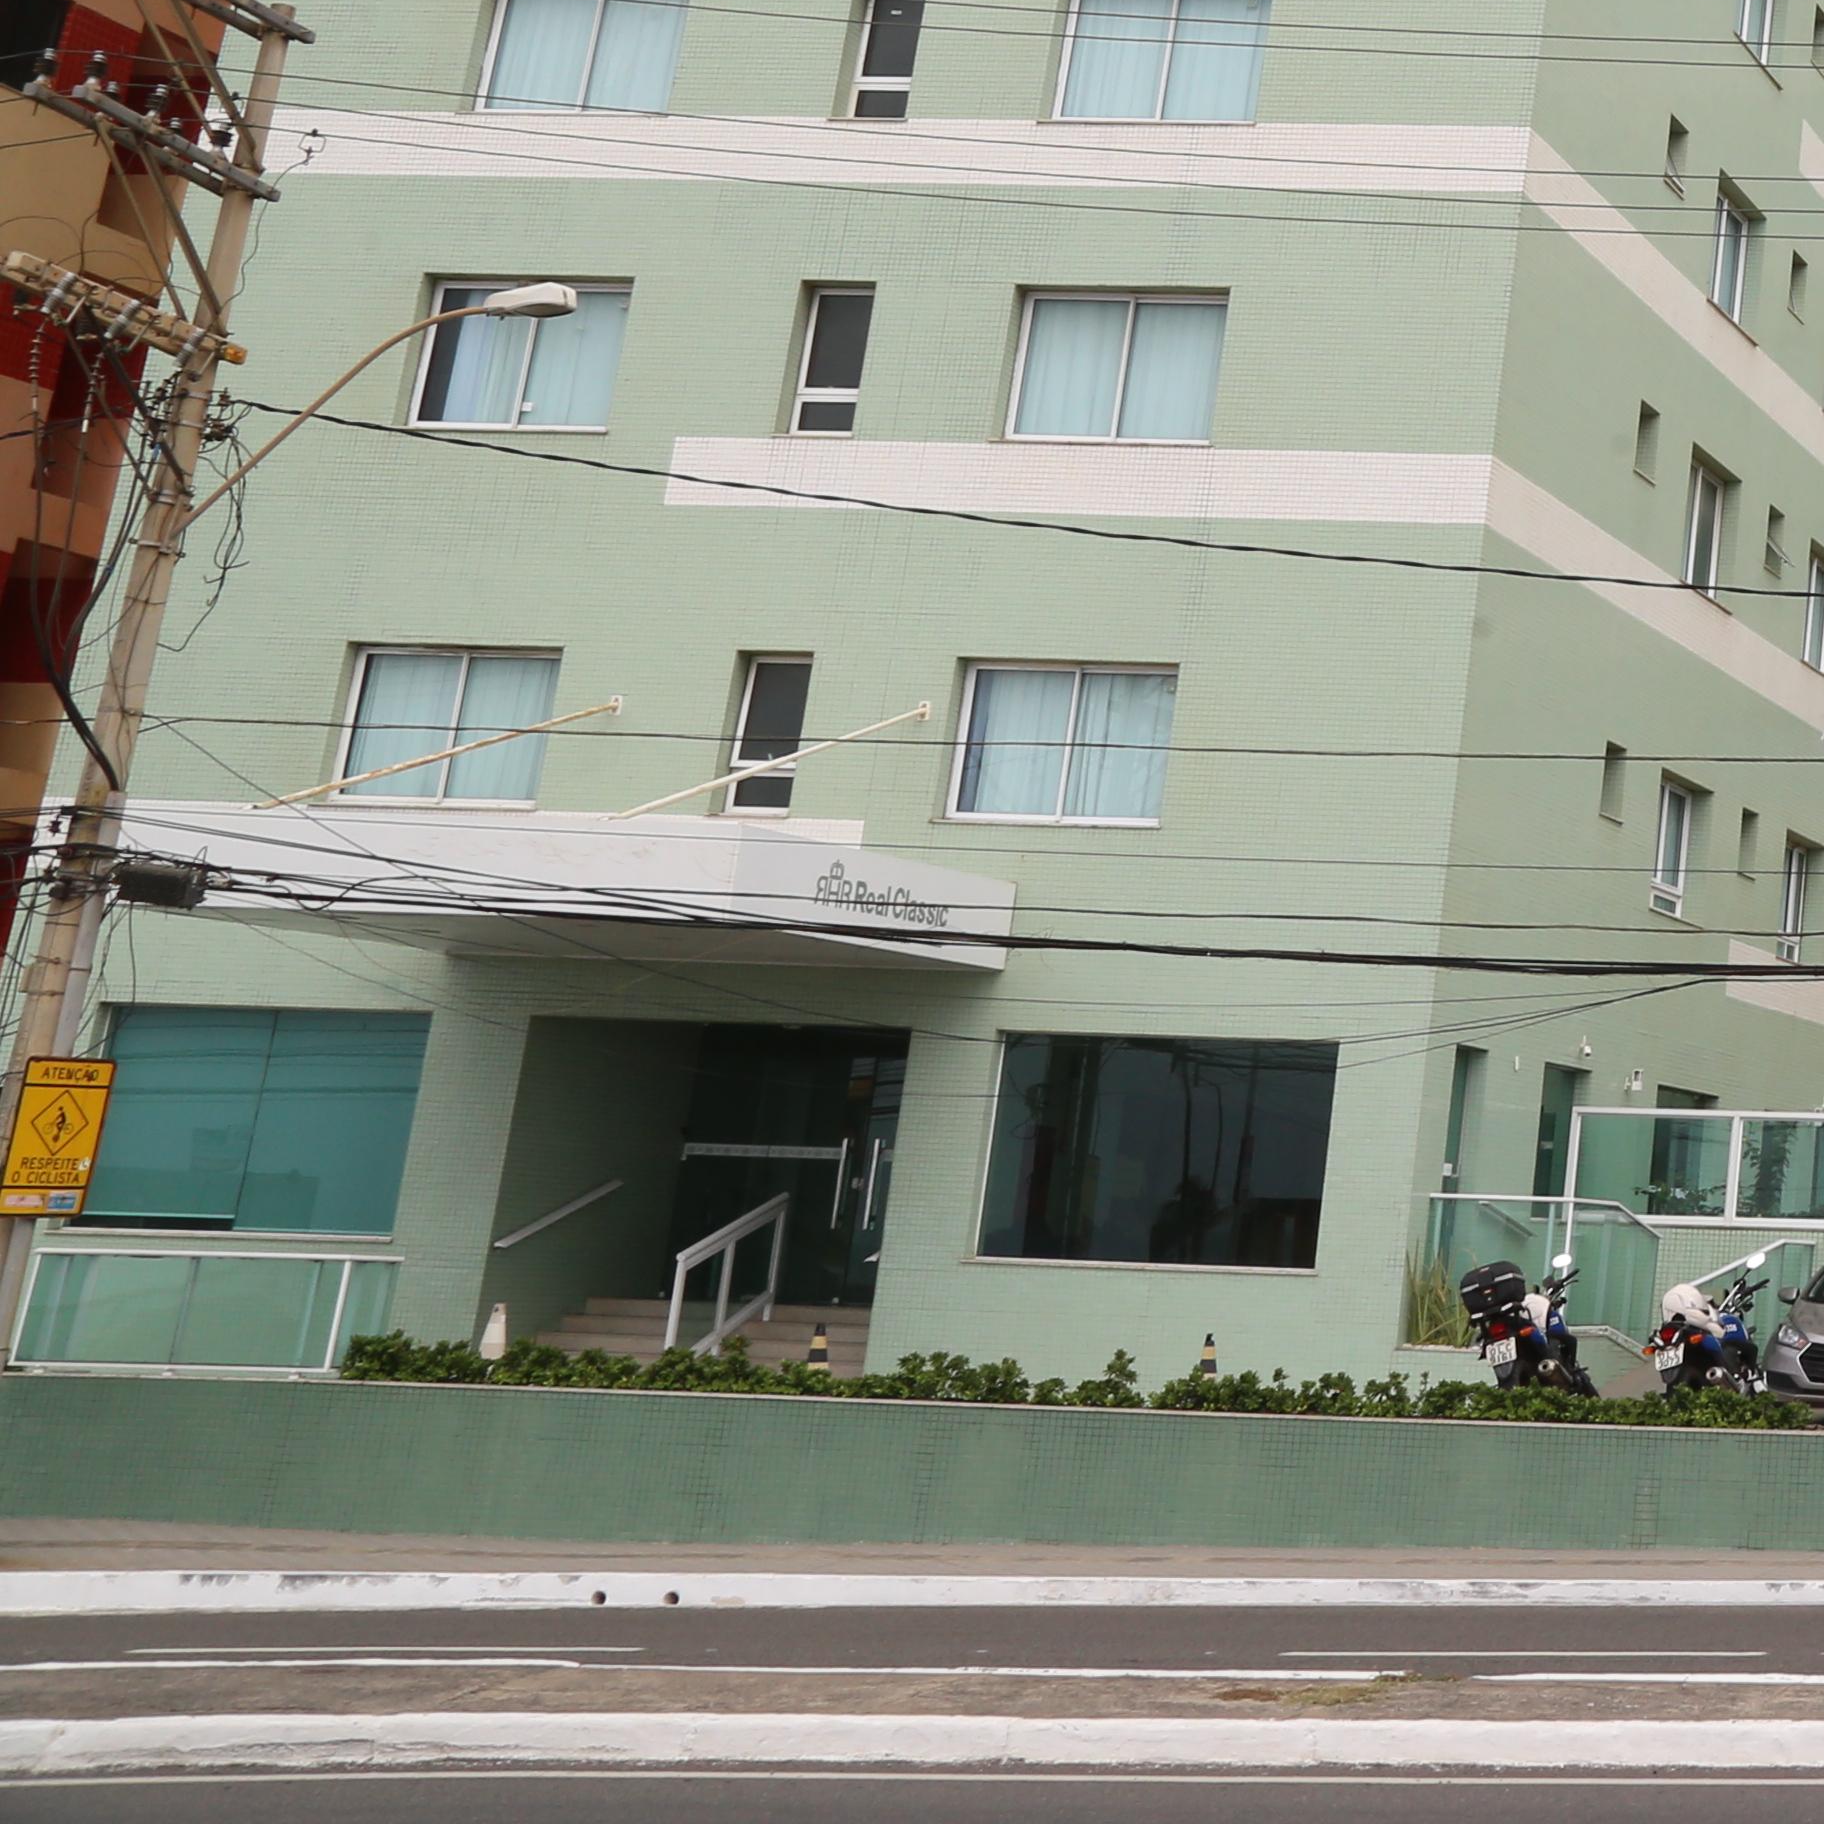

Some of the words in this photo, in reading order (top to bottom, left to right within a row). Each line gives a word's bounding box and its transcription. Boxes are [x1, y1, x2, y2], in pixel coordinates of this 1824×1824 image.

[852, 880, 892, 918] Real
[892, 887, 950, 927] Classic
[42, 1065, 100, 1084] ATENÇÃO
[20, 1156, 80, 1171] RESPEITE
[11, 1171, 21, 1184] O
[26, 1171, 81, 1185] CICLISTA
